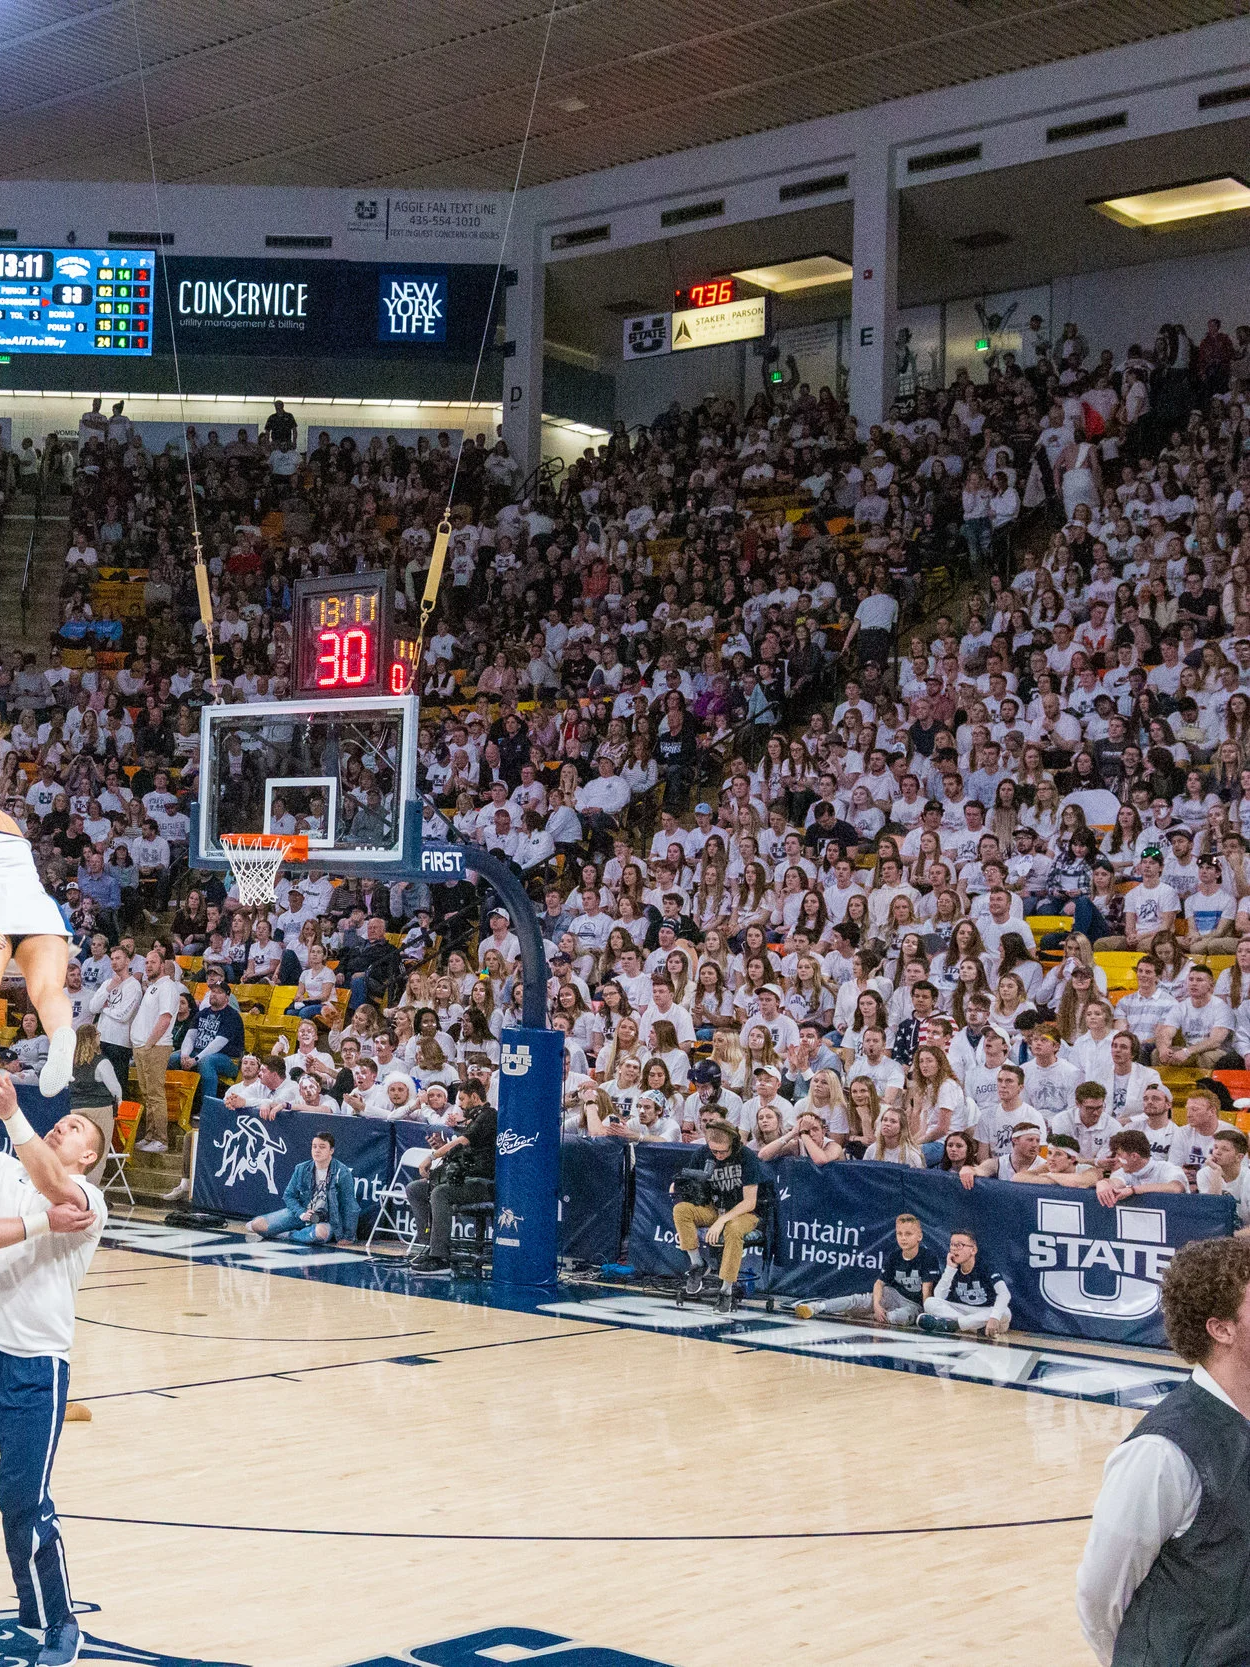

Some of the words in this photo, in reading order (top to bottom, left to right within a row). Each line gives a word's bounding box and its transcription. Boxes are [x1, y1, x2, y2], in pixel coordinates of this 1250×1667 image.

[394, 202, 424, 212] AGGIE
[428, 202, 446, 213] FAN
[450, 203, 473, 214] TEXT
[476, 204, 497, 214] LINE
[410, 216, 481, 226] 435-554-1010
[118, 270, 130, 280] 14
[139, 270, 147, 280] 2
[32, 286, 39, 295] 2
[120, 287, 127, 297] 0
[139, 287, 145, 297] 1
[391, 282, 438, 300] NEW
[33, 311, 39, 320] 3
[118, 304, 129, 314] 10
[139, 304, 145, 314] 1
[383, 297, 443, 318] YORK
[696, 314, 726, 326] STAKER
[732, 306, 764, 318] PARSON
[78, 323, 84, 332] 0
[99, 320, 111, 330] 15
[119, 321, 126, 331] 0
[138, 320, 144, 331] 1
[179, 318, 202, 330] utility
[204, 320, 266, 330] management
[268, 320, 276, 329] &
[278, 320, 305, 331] billing
[390, 316, 436, 334] LIFE
[97, 337, 110, 347] 24
[118, 337, 126, 347] 4
[138, 337, 144, 348] 1
[628, 328, 666, 344] STATE
[860, 327, 874, 346] E
[511, 386, 522, 402] D
[318, 630, 366, 686] 30
[392, 664, 404, 693] 0
[422, 851, 462, 871] FIRST
[500, 1132, 539, 1155] Sabor!
[801, 1244, 883, 1270] Hospital
[1028, 1233, 1175, 1284] STATE
